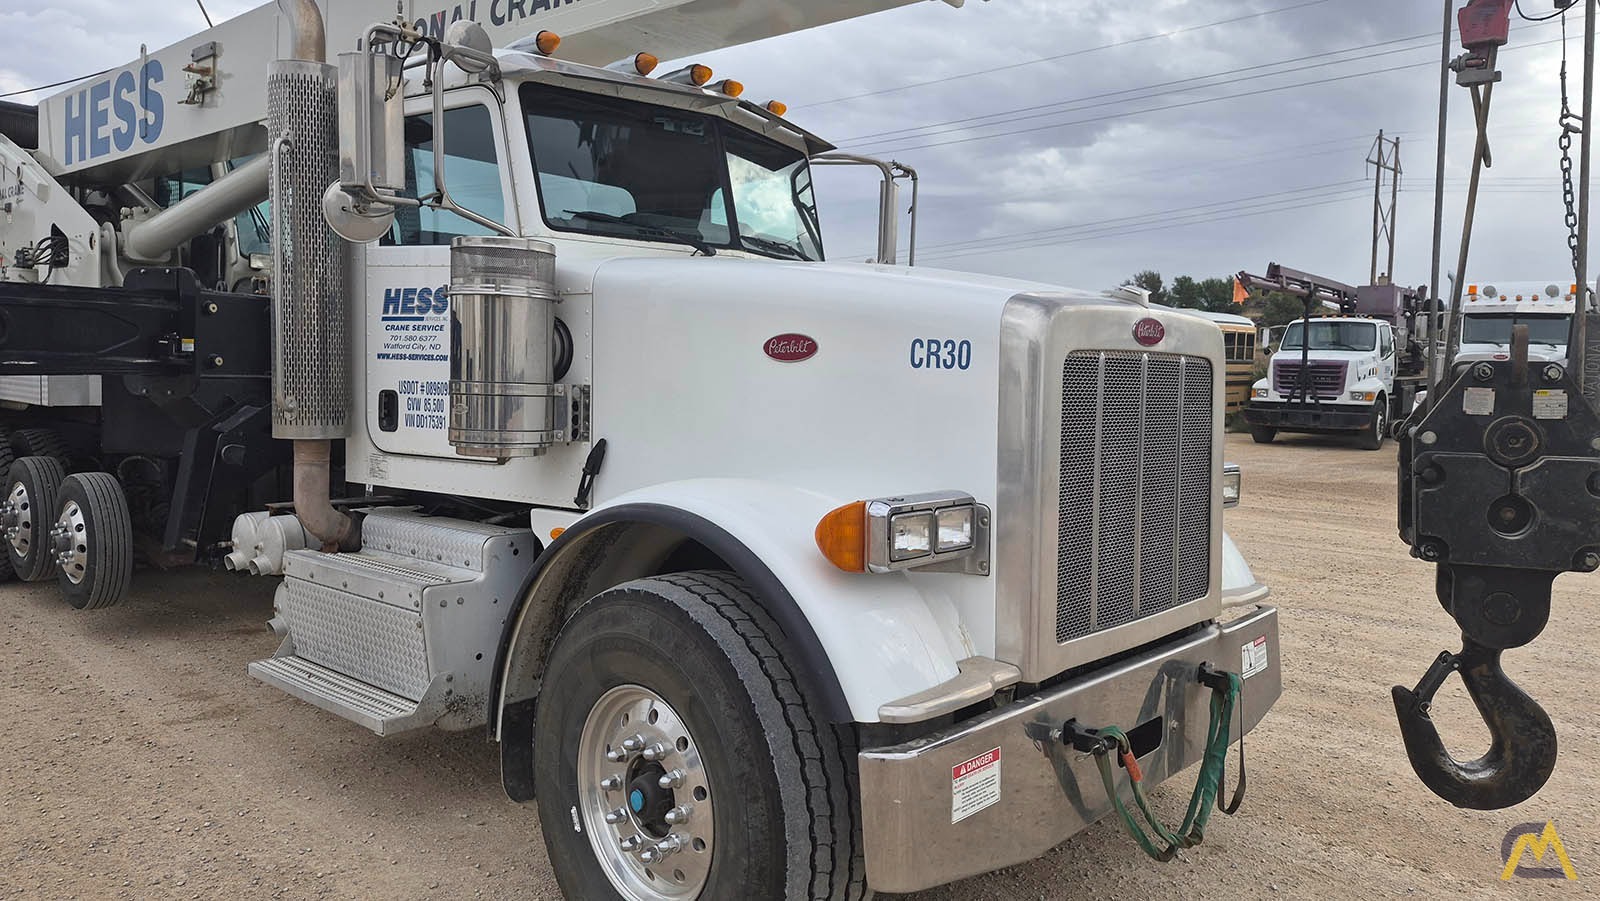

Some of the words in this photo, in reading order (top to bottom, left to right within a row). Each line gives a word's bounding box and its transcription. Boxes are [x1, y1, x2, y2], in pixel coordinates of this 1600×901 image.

[64, 59, 166, 166] HESS
[382, 287, 448, 315] HESS
[412, 324, 444, 332] SERVICE
[383, 342, 411, 350] Watford
[411, 342, 428, 351] City,
[768, 339, 812, 354] Peterbilt
[910, 338, 972, 370] CR30
[377, 353, 448, 361] WWW.HESS-SERVICES.COM
[399, 380, 419, 395] USDOT
[407, 397, 421, 411] GVW
[424, 398, 444, 413] 85,500
[405, 413, 416, 428] VIN
[967, 753, 993, 771] DANGER
